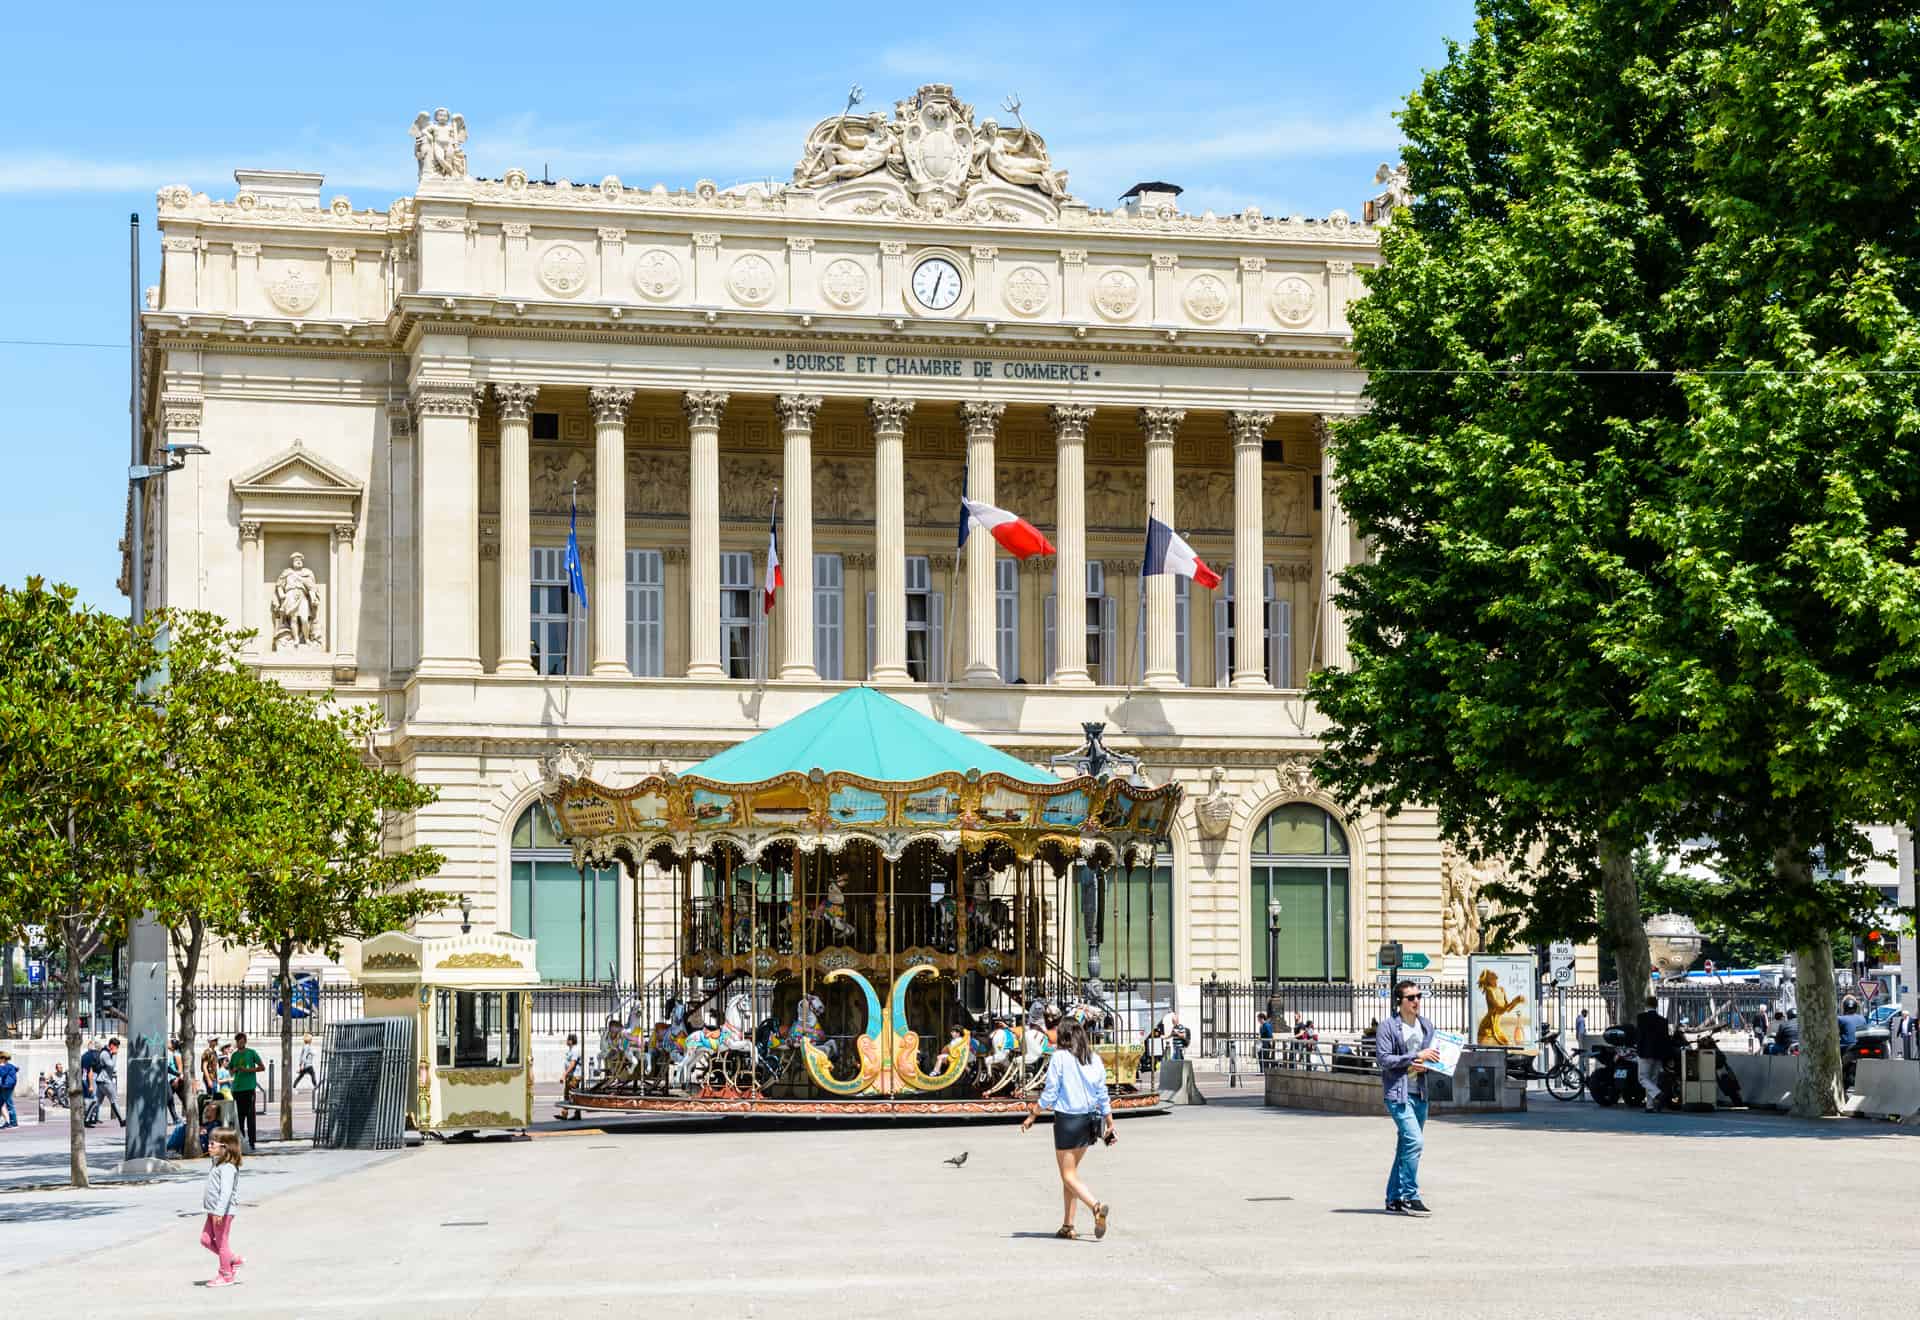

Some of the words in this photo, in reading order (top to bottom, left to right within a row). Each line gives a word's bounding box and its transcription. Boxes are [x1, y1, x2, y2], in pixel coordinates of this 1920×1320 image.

[786, 354, 846, 372] BOURSE
[856, 356, 877, 373] ET
[885, 358, 962, 376] CHAMBRE
[974, 361, 993, 377] DE
[1003, 362, 1089, 381] COMMERCE
[1558, 970, 1568, 978] 30
